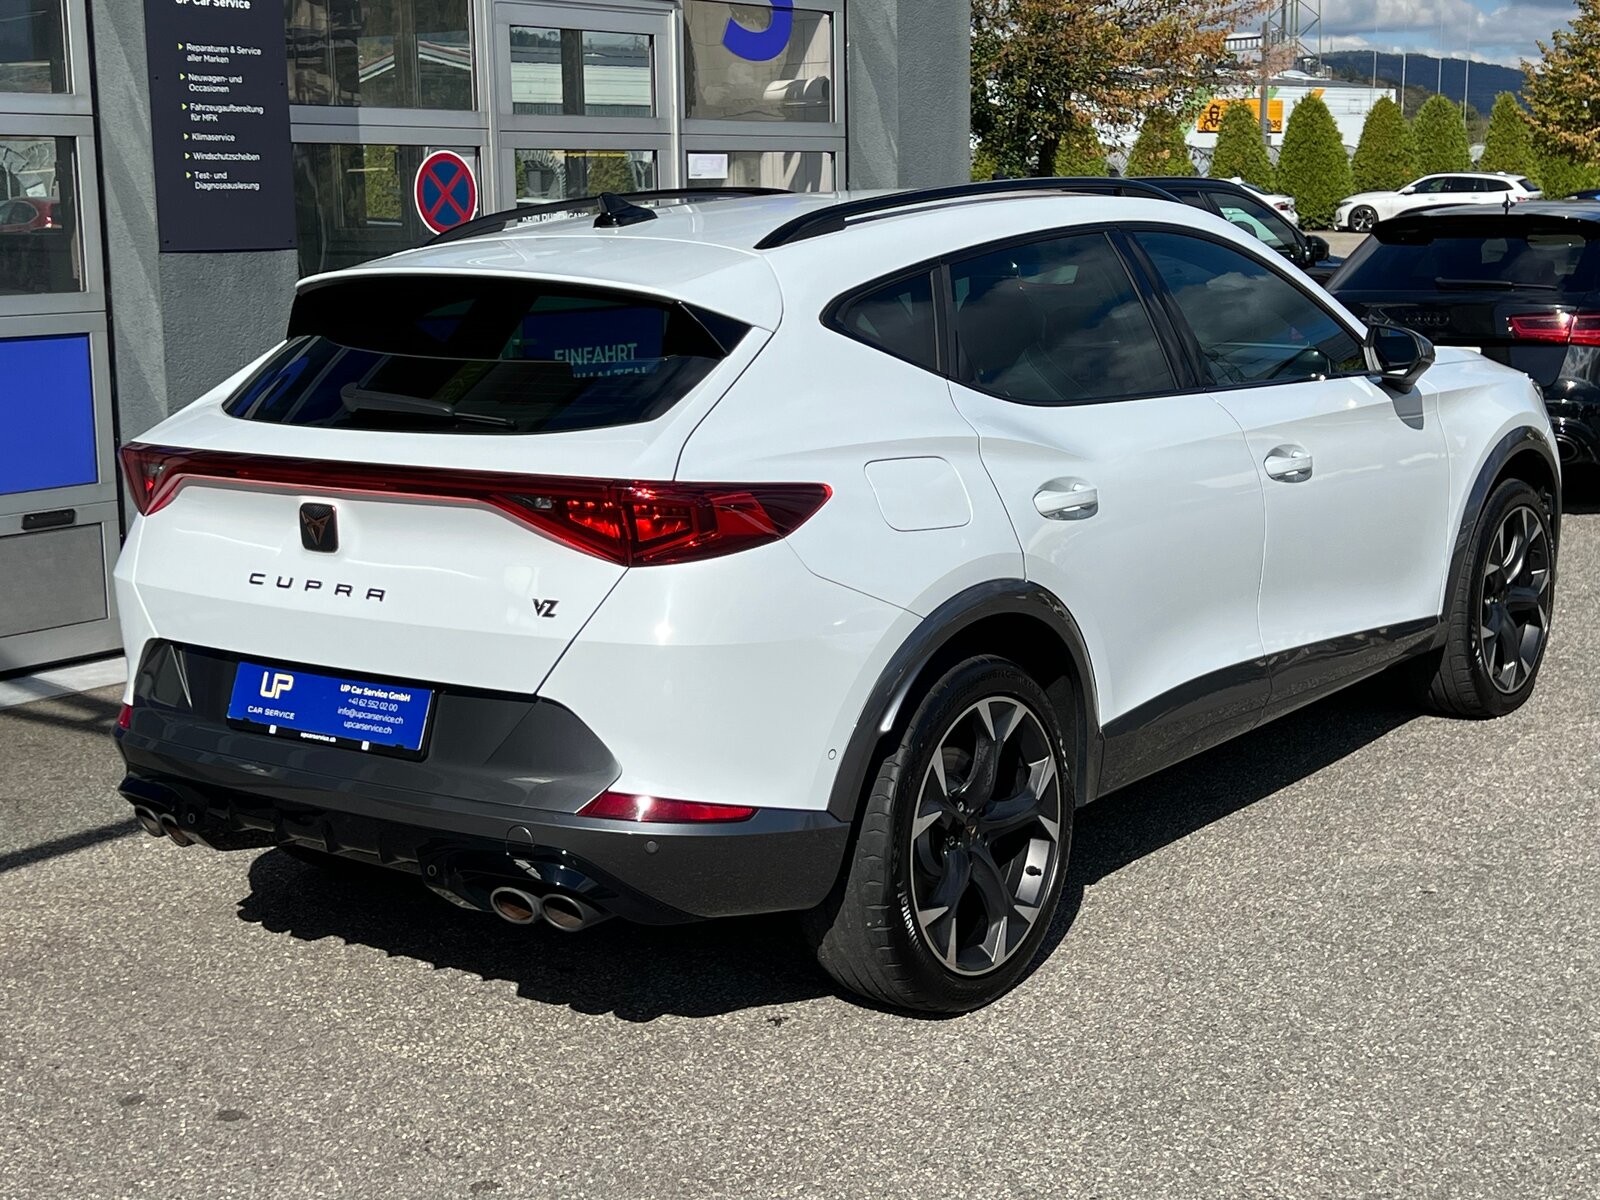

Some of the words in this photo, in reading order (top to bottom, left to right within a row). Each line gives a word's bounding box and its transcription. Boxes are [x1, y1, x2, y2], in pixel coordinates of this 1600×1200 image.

[213, 0, 251, 9] Service
[186, 43, 229, 54] Reparaturen
[230, 46, 236, 54] &
[237, 46, 262, 55] Service
[186, 54, 202, 62] aller
[203, 55, 229, 63] Marken
[188, 73, 228, 83] Neuwagen-
[228, 75, 243, 83] und
[188, 83, 230, 93] Occasionen
[190, 103, 264, 115] Fahrzeugaufbereitung
[190, 113, 201, 121] für
[202, 114, 218, 122] MFK
[191, 133, 236, 142] Klimaservice
[193, 152, 260, 161] Windschutzscheiben
[194, 171, 213, 180] Test-
[213, 172, 228, 180] und
[195, 182, 260, 191] Diagnoseauslesung
[554, 343, 638, 367] EINFAHRT
[249, 573, 386, 602] CUPRA
[532, 598, 559, 618] VZ
[260, 671, 294, 699] UP
[340, 684, 351, 692] UP
[351, 686, 363, 695] Car
[363, 688, 388, 699] Service
[389, 692, 411, 702] GmbH
[348, 698, 358, 706] +41
[359, 698, 367, 707] 62
[380, 702, 388, 711] 02
[389, 704, 398, 712] 00
[247, 705, 263, 714] CAR
[264, 708, 295, 720] SERVICE
[337, 706, 404, 724] info@upcarservice.ch
[344, 721, 392, 734] upcarservice.ch
[300, 732, 336, 743] upcarservice.ch
